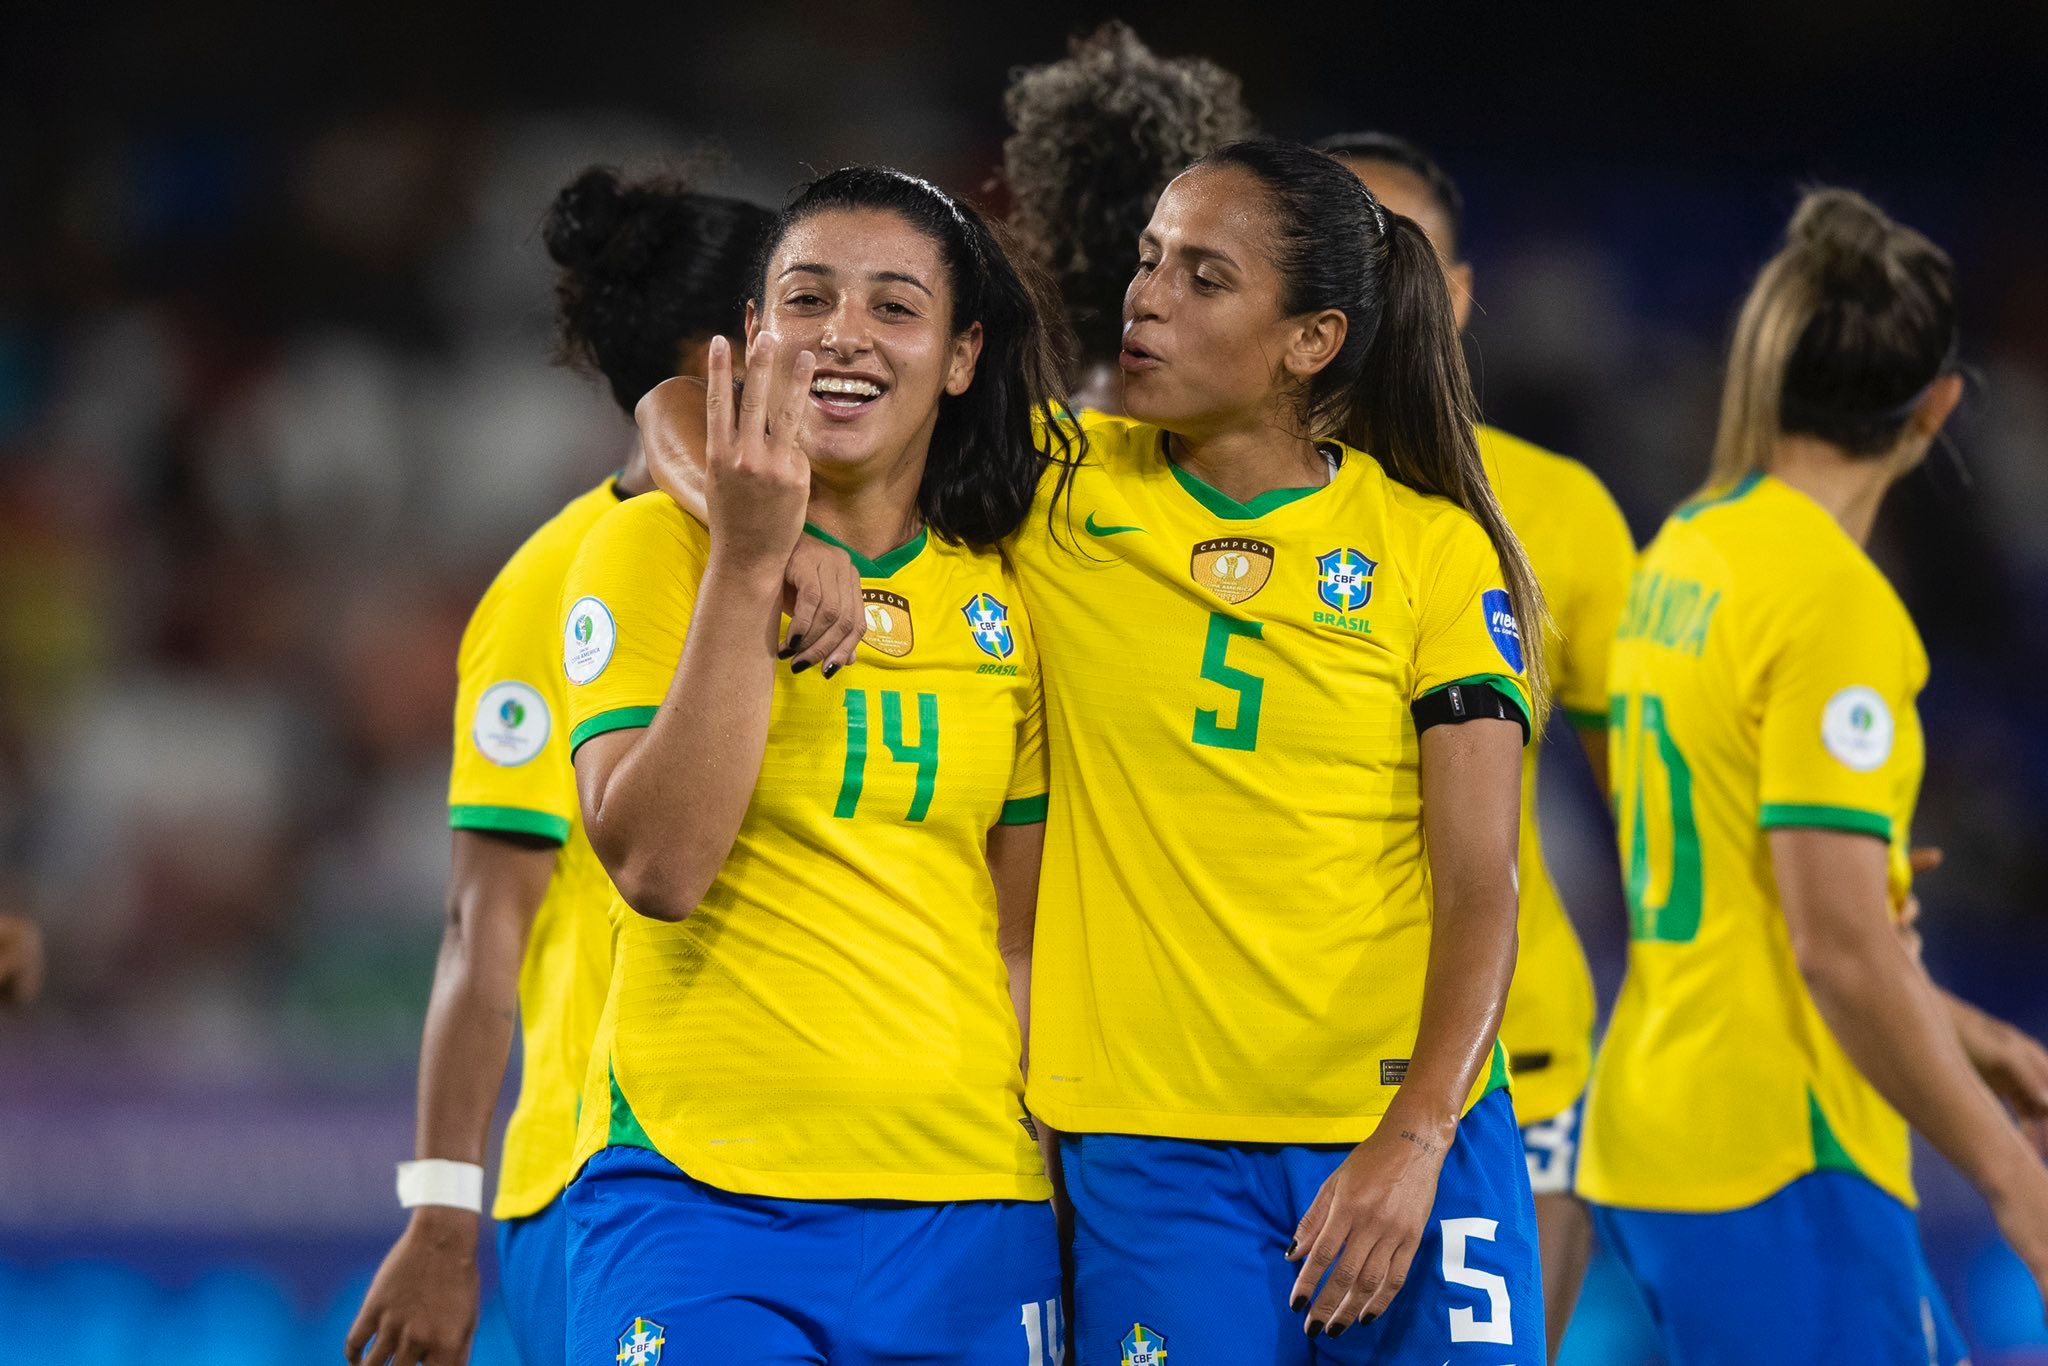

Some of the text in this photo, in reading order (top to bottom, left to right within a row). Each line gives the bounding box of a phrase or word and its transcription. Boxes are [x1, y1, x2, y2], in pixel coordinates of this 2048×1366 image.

[1200, 541, 1269, 554] CAMPEÓN
[1333, 574, 1356, 584] CBF
[862, 593, 904, 607] MPEÓN
[979, 622, 997, 631] CBF
[1313, 611, 1372, 634] BRASIL
[976, 664, 1018, 676] BRASIL
[1191, 611, 1266, 752] 5
[833, 688, 939, 822] 14
[1440, 1217, 1513, 1345] 5
[630, 1342, 650, 1355] CBF
[1133, 1353, 1153, 1364] CBF
